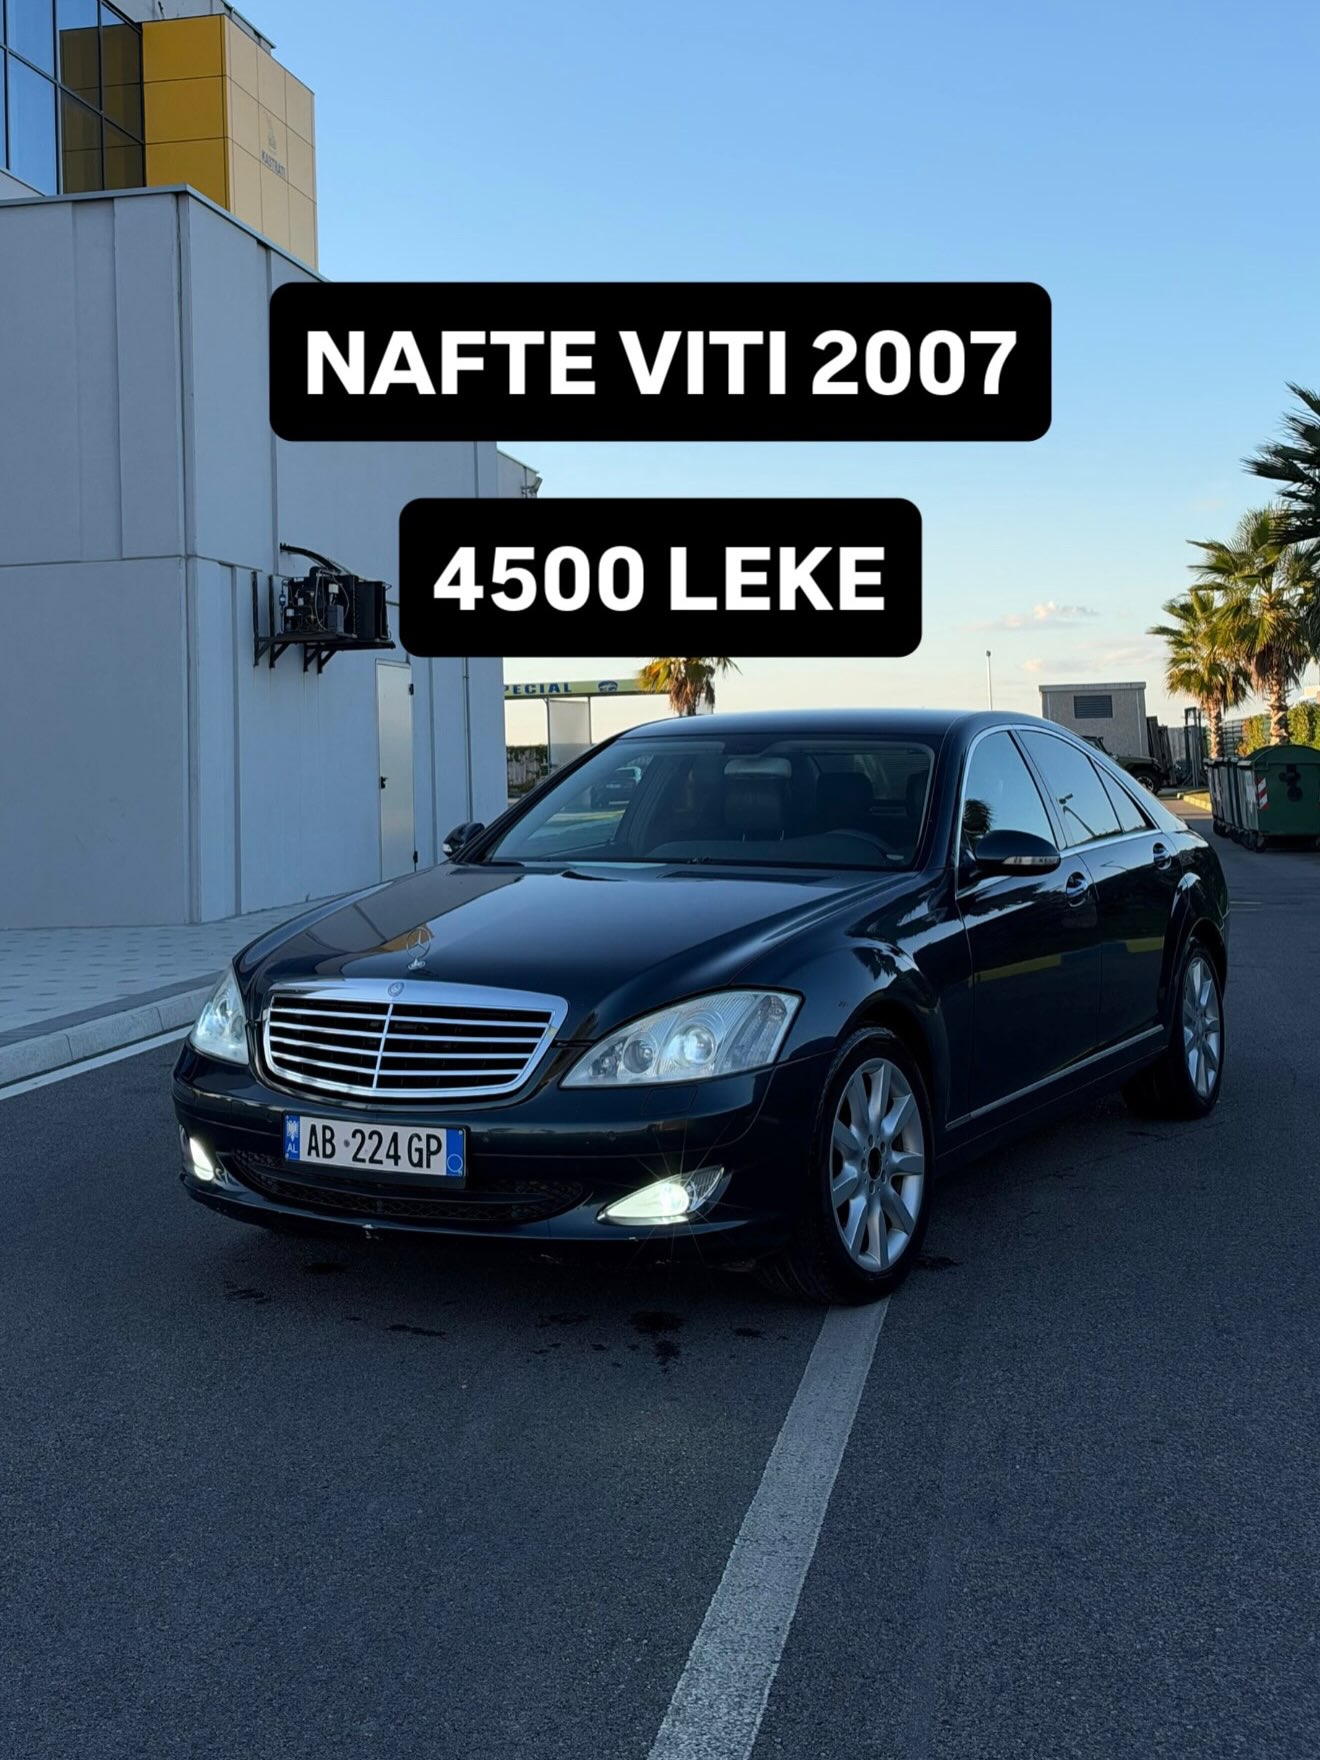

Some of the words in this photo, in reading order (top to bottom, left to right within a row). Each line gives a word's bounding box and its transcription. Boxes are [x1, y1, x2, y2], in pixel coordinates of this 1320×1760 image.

[287, 1143, 298, 1153] AL
[307, 1123, 336, 1159] AB
[351, 1128, 401, 1166] 224
[407, 1132, 443, 1169] GP
